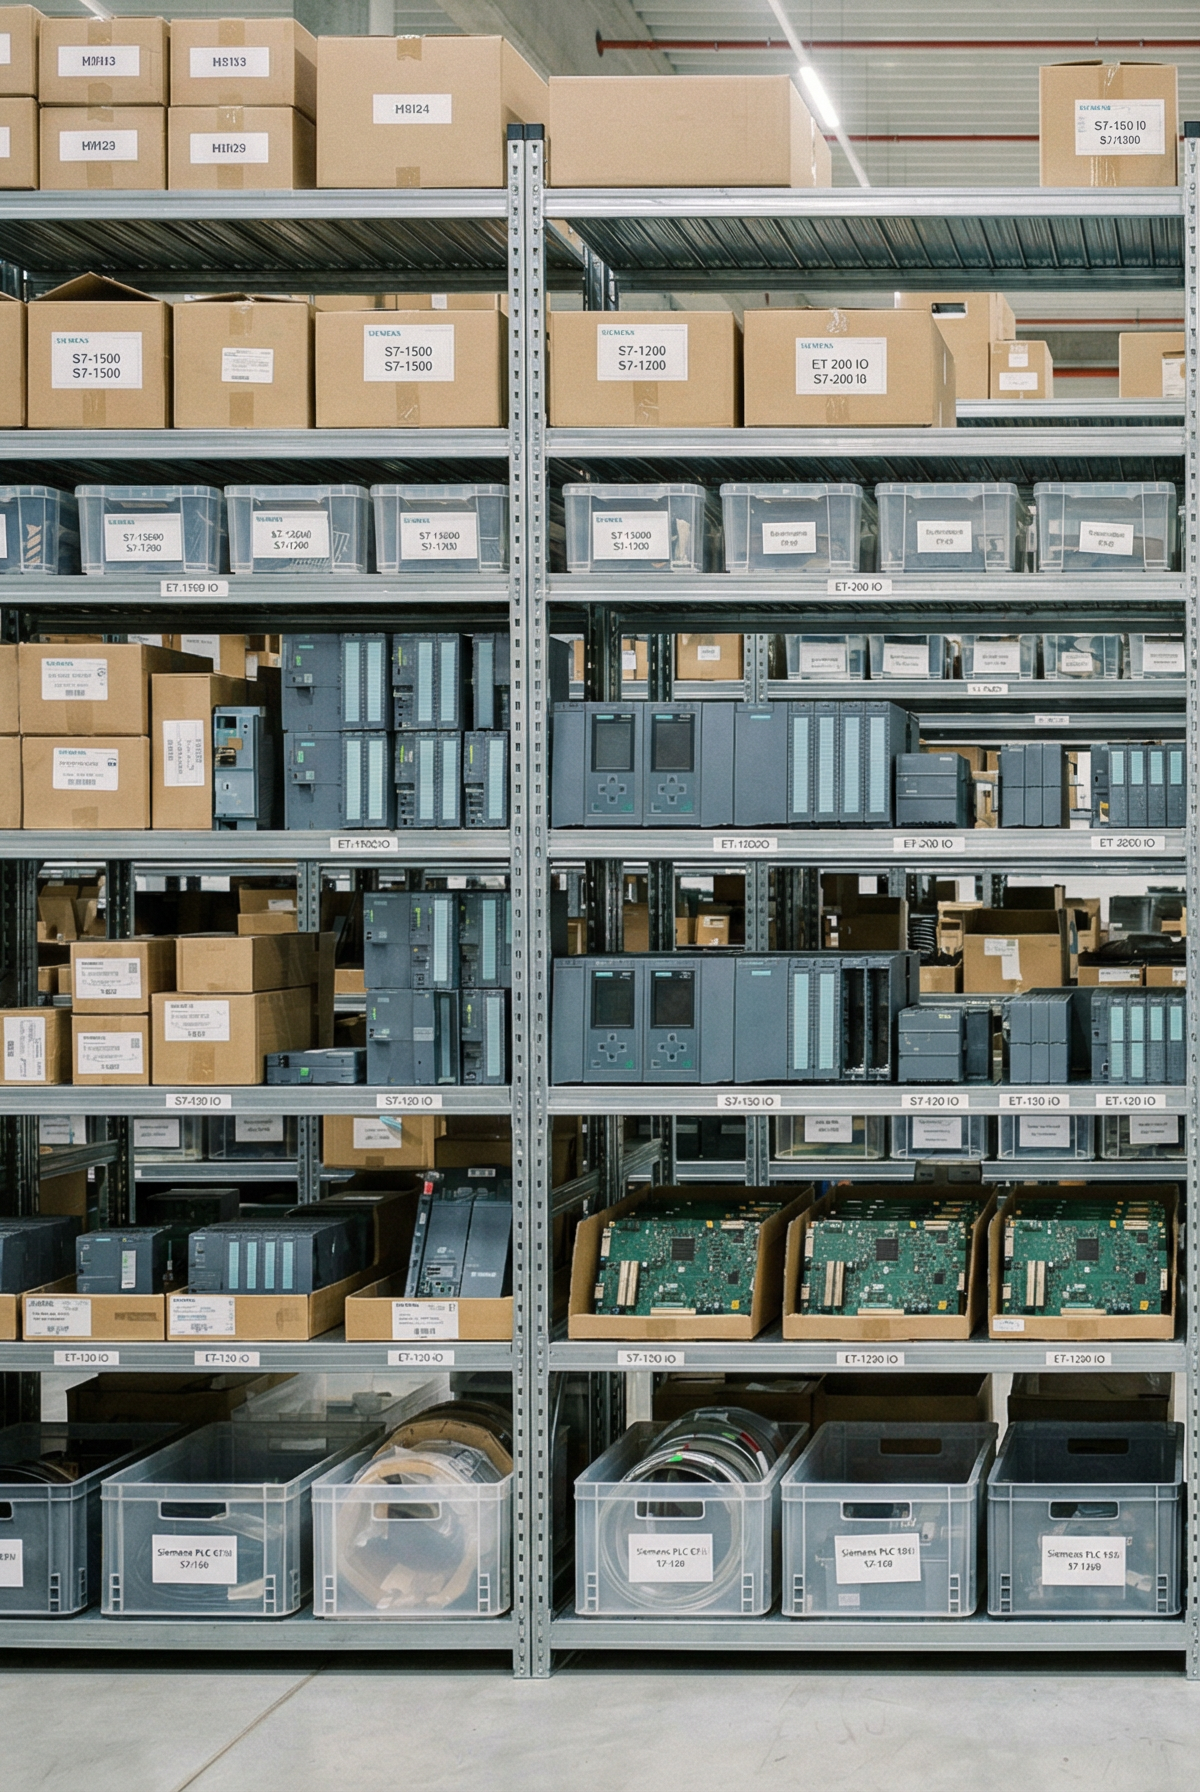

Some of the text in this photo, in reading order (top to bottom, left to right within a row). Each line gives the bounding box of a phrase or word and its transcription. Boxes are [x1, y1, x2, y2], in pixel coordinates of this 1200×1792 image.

[384, 346, 432, 357] S7-1500
[618, 345, 666, 356] S7-1200
[72, 353, 121, 364] S7-1500
[384, 360, 433, 372] S7-1500
[618, 360, 666, 371] S7-1200
[812, 358, 869, 370] ET 200 IO
[72, 367, 121, 379] S7-1500
[813, 374, 854, 384] S7-200
[871, 582, 883, 592] IO
[941, 839, 954, 849] IO
[1100, 838, 1114, 848] ET
[1143, 838, 1156, 848] IO
[210, 1096, 222, 1106] IO
[421, 1096, 433, 1106] IO
[762, 1096, 774, 1106] IO
[947, 1096, 960, 1106] IO
[98, 1353, 109, 1362] IO
[664, 1354, 676, 1364] IO
[886, 1354, 898, 1364] IO
[1094, 1354, 1106, 1364] IO
[672, 1548, 688, 1556] PLC
